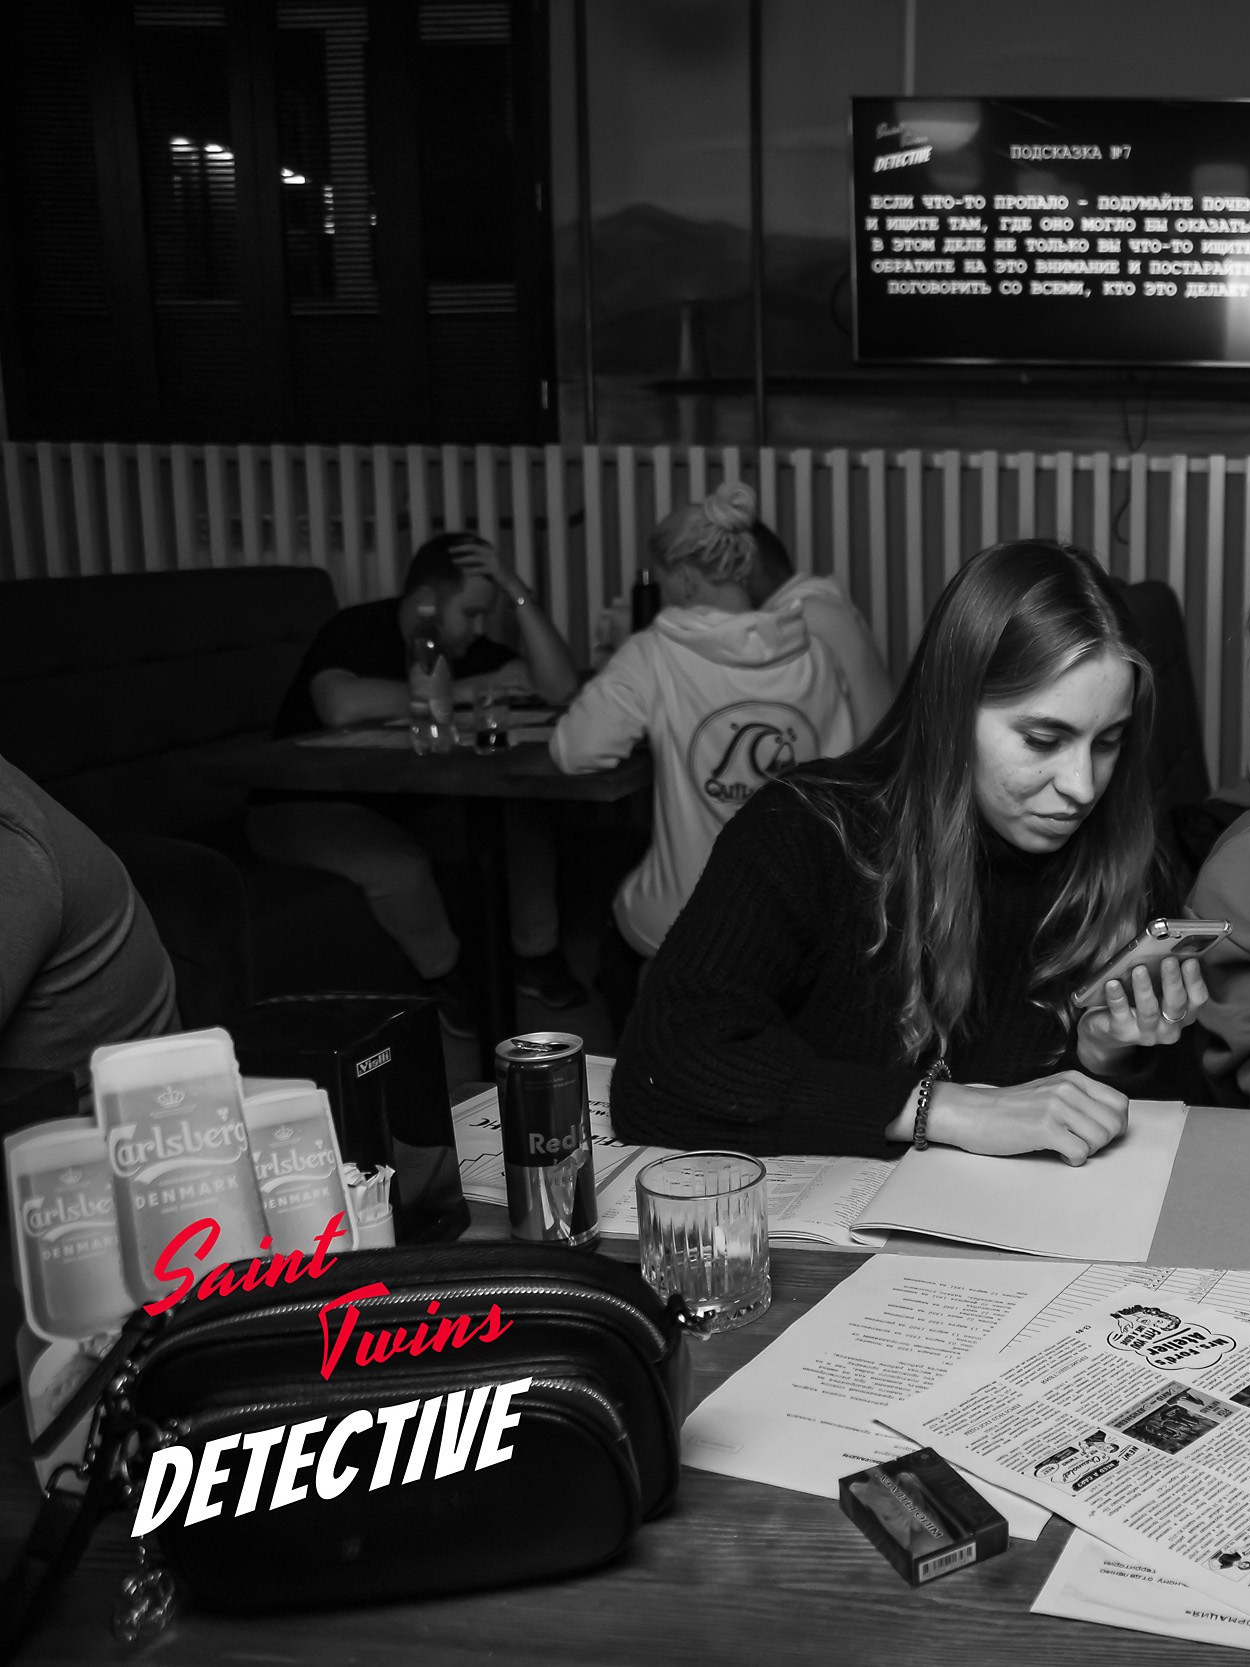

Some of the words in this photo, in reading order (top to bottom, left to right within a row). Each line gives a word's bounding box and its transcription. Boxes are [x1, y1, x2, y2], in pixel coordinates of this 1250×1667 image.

[873, 145, 934, 173] DETECTIVE
[1010, 145, 1102, 160] ПОДСКАЗКА
[1109, 145, 1132, 160] №7
[870, 195, 914, 210] ЕСЛИ
[921, 195, 986, 210] ЧТО-ТО
[994, 196, 1069, 211] ПРОПАЛО
[1097, 195, 1193, 212] ПОДУМАЙТЕ
[865, 217, 878, 231] И
[886, 217, 939, 231] ИЩИТЕ
[947, 218, 988, 235] ТАМ,
[999, 218, 1032, 232] ГДЕ
[1039, 219, 1074, 233] ОНО
[1081, 219, 1136, 233] МОГЛО
[871, 238, 884, 252] В
[891, 238, 936, 252] ЭТОМ
[942, 239, 986, 253] ДЕЛЕ
[994, 239, 1017, 253] НЕ
[1024, 239, 1090, 253] ТОЛЬКО
[1128, 240, 1193, 254] ЧТО-ТО
[871, 259, 955, 273] ОБРАТИТЕ
[964, 260, 987, 274] НА
[994, 260, 1028, 274] ЭТО
[1035, 260, 1120, 274] ВНИМАНИЕ
[1127, 261, 1141, 275] И
[888, 280, 992, 295] ПОГОВОРИТЬ
[999, 281, 1023, 296] СО
[1030, 281, 1092, 299] ВСЕМИ,
[1102, 282, 1136, 297] КТО
[1143, 282, 1177, 297] ЭТО
[528, 1125, 577, 1154] Red
[108, 1121, 249, 1179] Carlsberg
[253, 1147, 338, 1181] arlsberg
[136, 1176, 240, 1210] DENMARK
[23, 1194, 113, 1237] Carlsbe
[1146, 1332, 1207, 1356] Atelier
[1195, 1338, 1229, 1349] Mrs.
[1155, 1349, 1200, 1366] Ford's
[1123, 1445, 1139, 1462] NEW!
[1099, 1462, 1116, 1476] NEED
